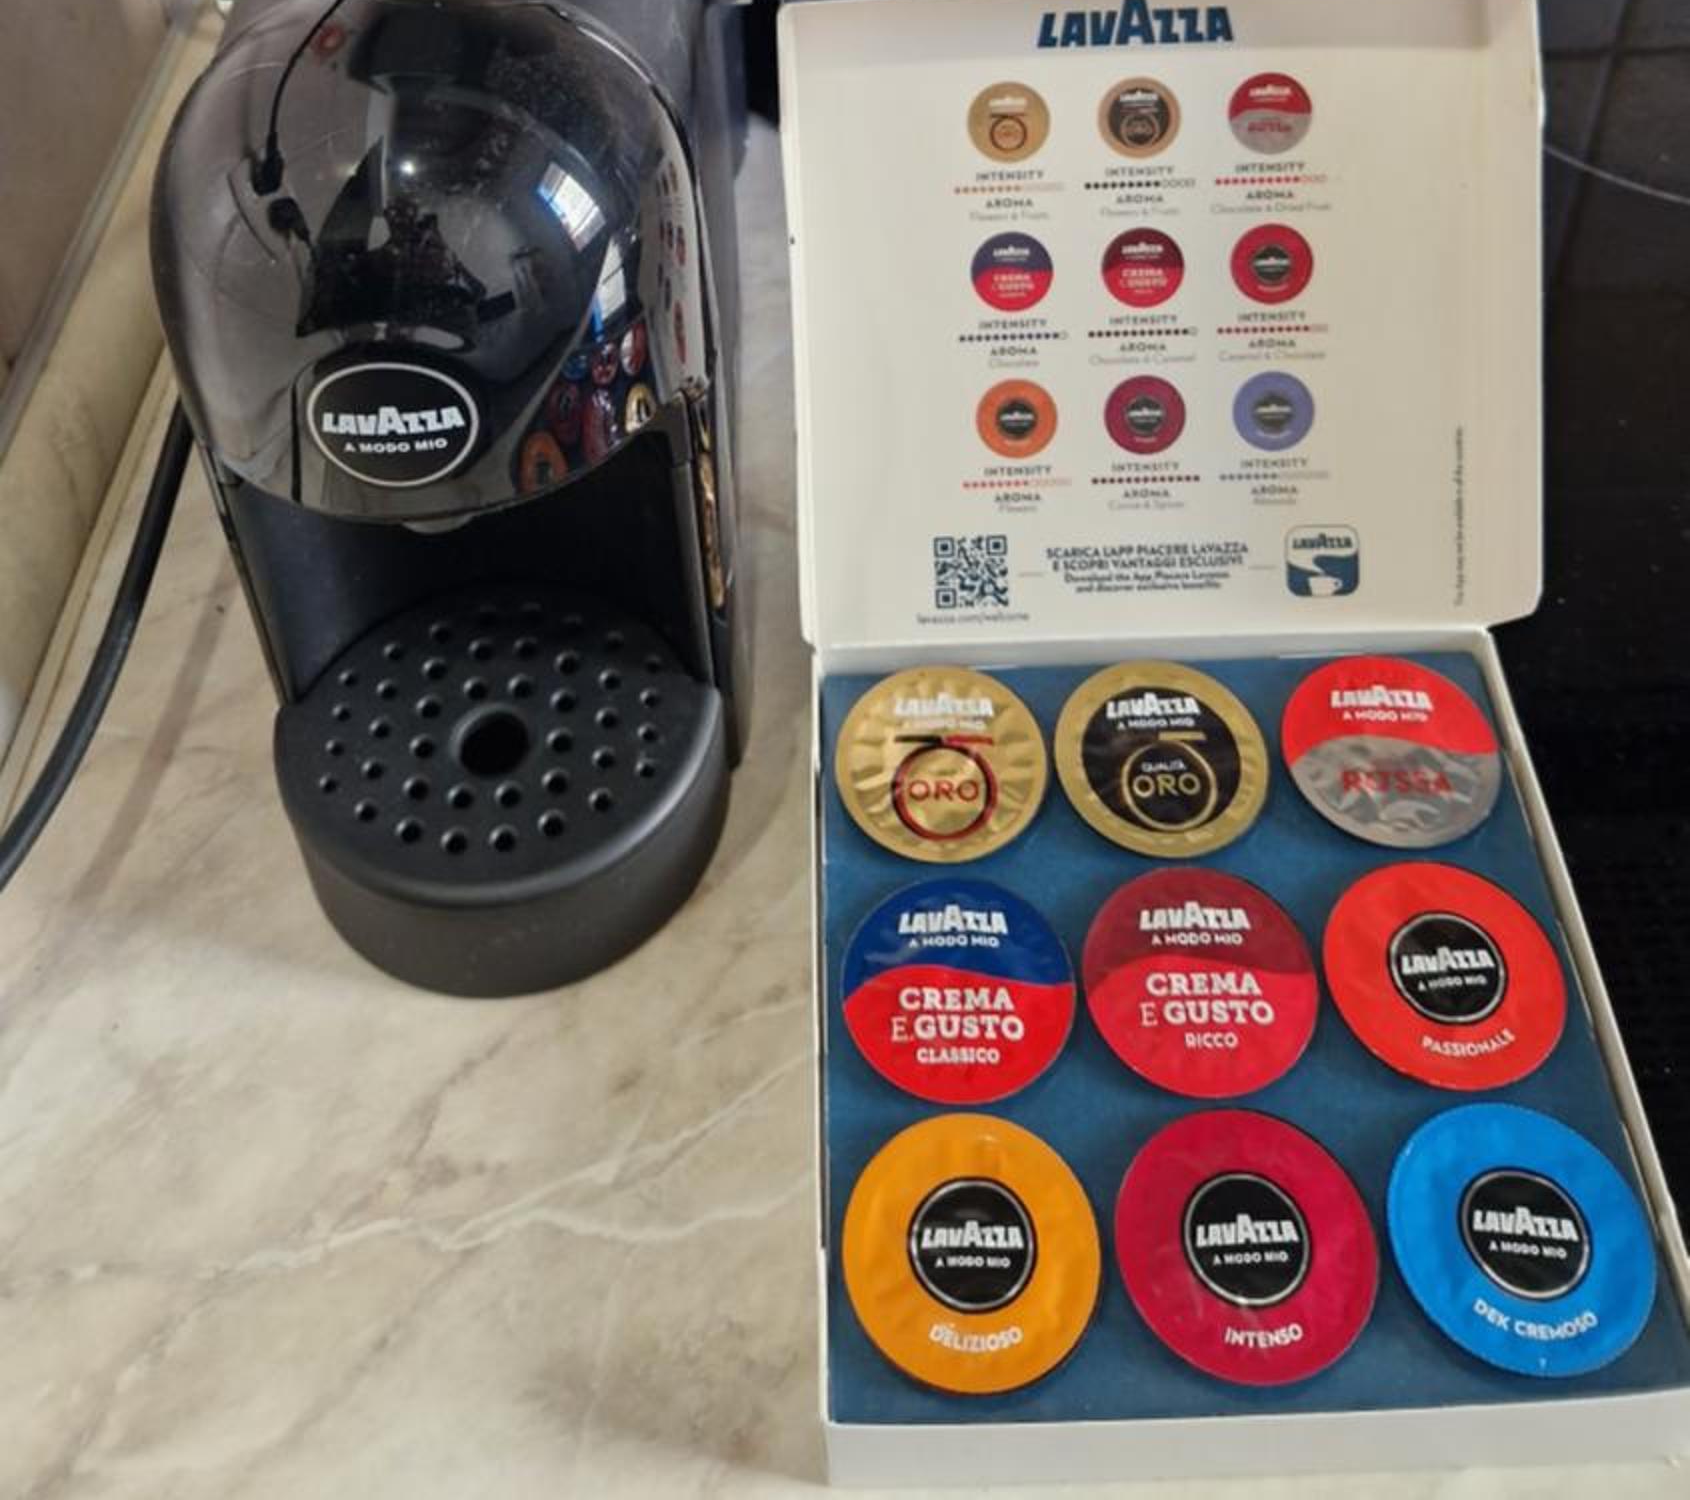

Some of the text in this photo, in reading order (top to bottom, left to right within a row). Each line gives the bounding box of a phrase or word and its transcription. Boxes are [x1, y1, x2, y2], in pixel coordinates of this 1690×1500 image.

[976, 170, 1043, 182] INTENSITY
[1105, 165, 1174, 177] INTENSITY
[1235, 162, 1304, 173] INTENSITY
[1116, 194, 1163, 204] AROMA
[1246, 189, 1294, 199] AROMA
[986, 198, 1033, 209] AROMA
[979, 319, 1047, 330] INTENSITY
[1109, 314, 1177, 325] INTENSITY
[1238, 311, 1305, 322] INTENSITY
[991, 346, 1037, 356] AROMA
[1120, 342, 1166, 352] AROMA
[1248, 338, 1296, 348] AROMA
[322, 406, 465, 436] LAVAZZA
[344, 437, 448, 454] A MODO MIO
[984, 465, 1051, 476] INTENSITY
[1111, 461, 1179, 471] INTENSITY
[1241, 457, 1308, 469] INTENSITY
[994, 492, 1041, 502] AROMA
[1123, 488, 1170, 498] AROMA
[1251, 485, 1298, 495] AROMA
[1292, 533, 1353, 549] LAVAZZA
[1047, 547, 1100, 560] SCARICA
[1137, 542, 1189, 556] PIACERE
[1192, 541, 1249, 555] LAVAZZA
[1064, 558, 1109, 571] SCOPRI
[1112, 556, 1176, 569] VANTAGGI
[1179, 554, 1244, 567] ESCLUSIVI
[895, 691, 994, 717] LAVAZZA
[1106, 691, 1200, 718] LAVAZZA
[1330, 684, 1434, 712] LAVAZZA
[1355, 710, 1398, 722] MODO
[908, 779, 980, 801] ORO
[1132, 772, 1201, 798] ORO
[898, 903, 1009, 935] LAVAZZA
[1139, 900, 1251, 931] LAVAZZA
[909, 934, 1000, 948] A MODO MIO
[1151, 932, 1243, 945] A MODO MIO
[1401, 946, 1495, 975] LAVAZZA
[1145, 971, 1263, 997] CREMA
[1417, 981, 1427, 992] A
[899, 986, 1015, 1011] CREMA
[1139, 999, 1276, 1028] E GUSTO
[890, 1013, 1026, 1043] E GUSTO
[1184, 1031, 1239, 1050] RICCO
[1421, 1028, 1516, 1058] PASSIONALE
[916, 1047, 1000, 1065] CLASSICO
[1196, 1213, 1299, 1248] LAVAZZA
[1472, 1206, 1580, 1242] LAVAZZA
[921, 1220, 1025, 1249] LAVAZZA
[1213, 1250, 1289, 1266] A MODO MIO
[1489, 1240, 1567, 1259] A MODO MIO
[934, 1255, 1011, 1268] A MODO MIO
[1473, 1298, 1599, 1341] DEK CREMOSO
[929, 1323, 1023, 1353] DELIZIOSO
[1224, 1323, 1303, 1349] INTENSO
